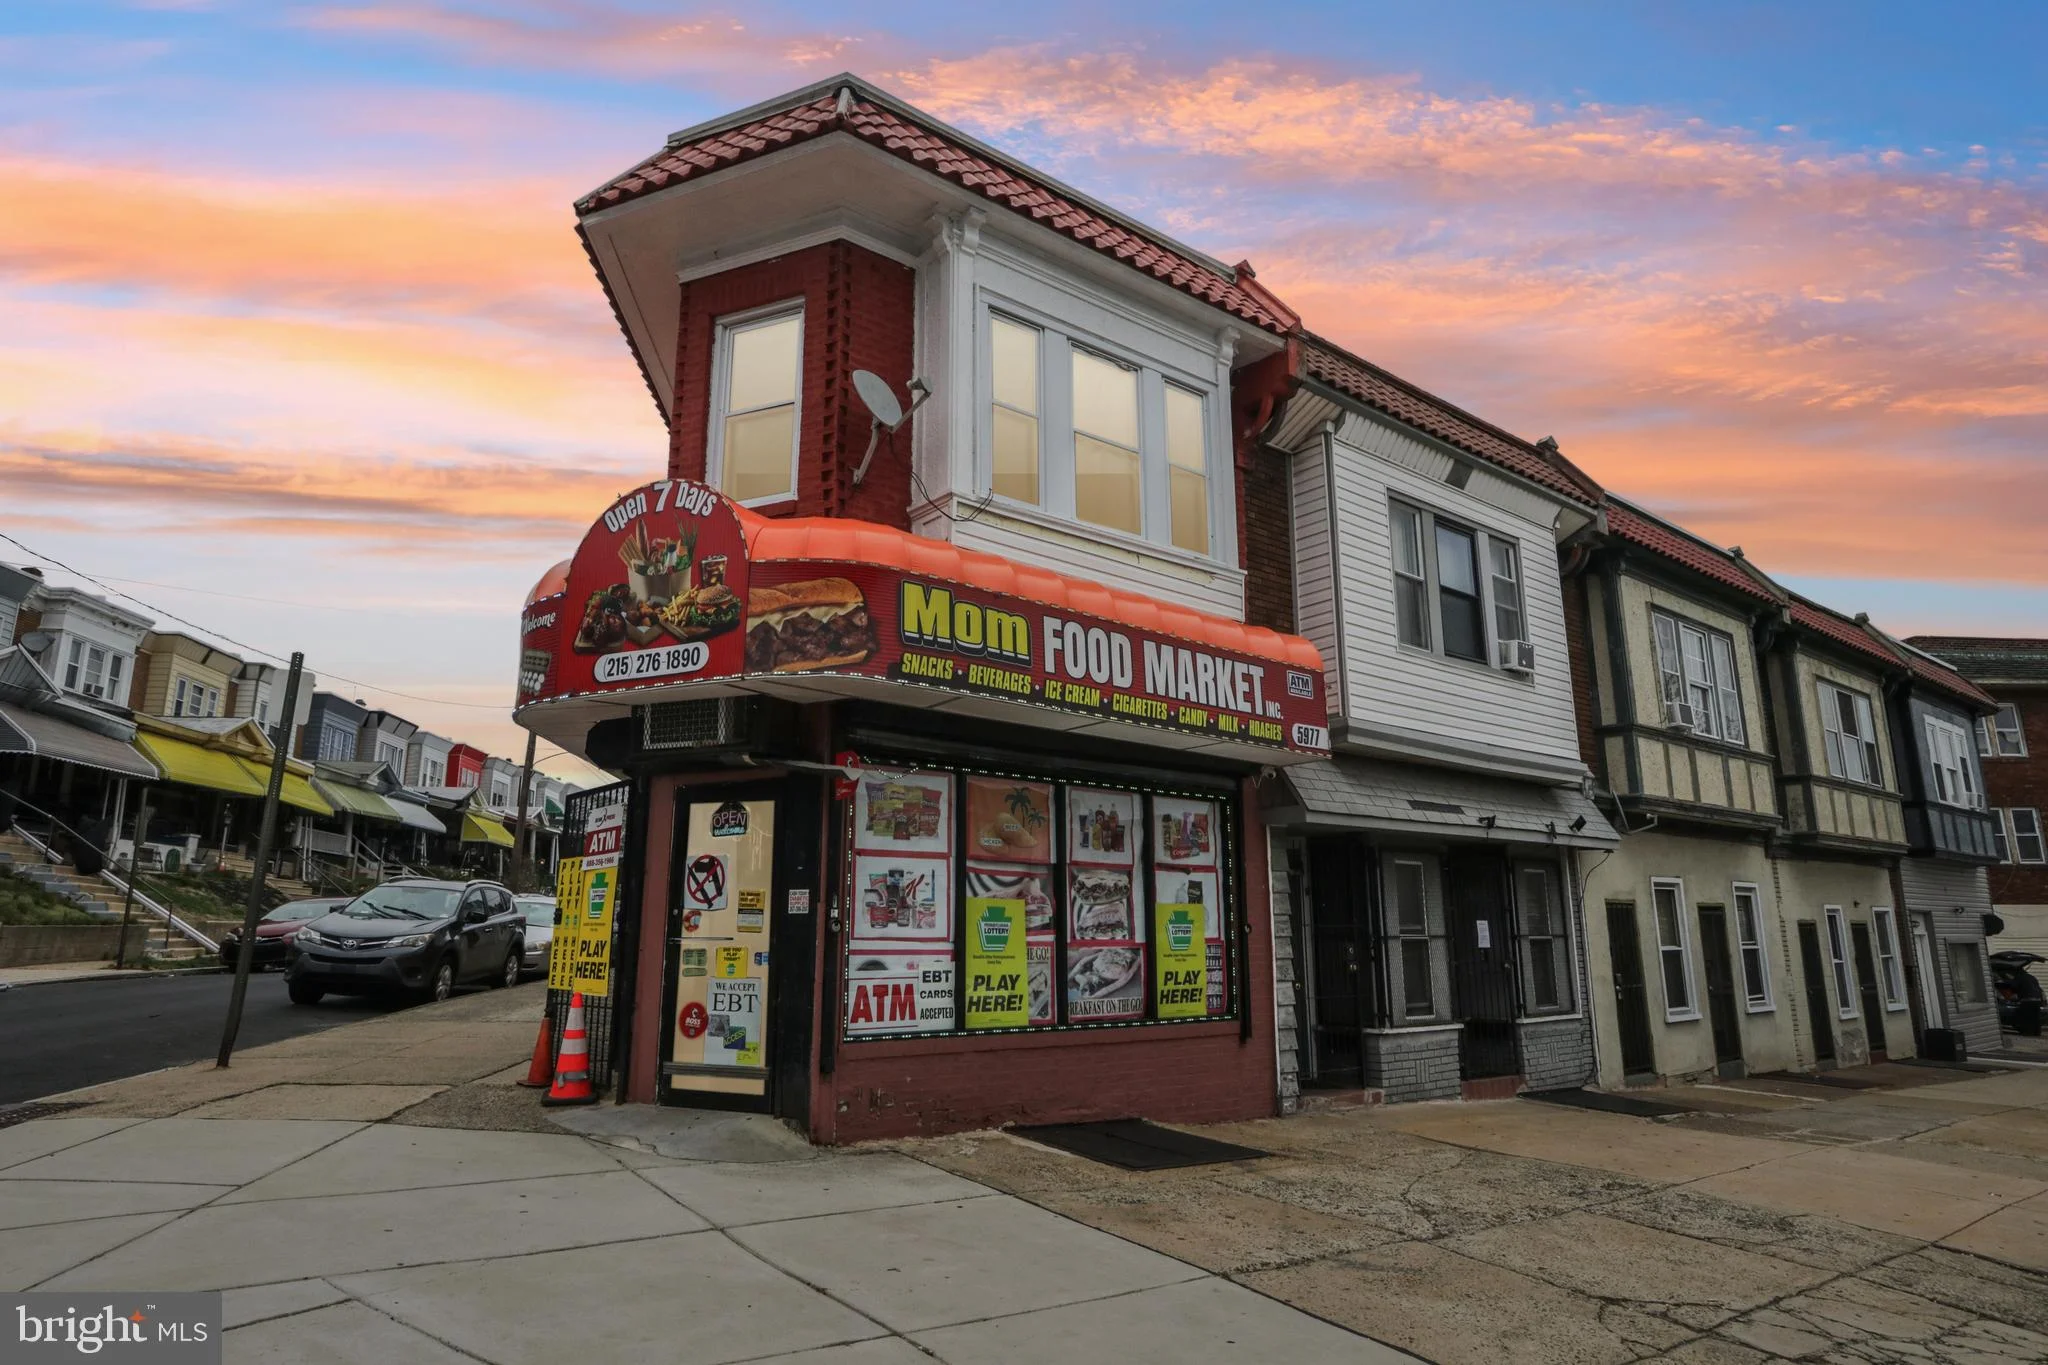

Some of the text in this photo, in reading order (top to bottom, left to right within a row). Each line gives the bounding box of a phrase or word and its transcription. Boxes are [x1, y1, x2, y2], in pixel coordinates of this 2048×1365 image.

[604, 481, 718, 533] Open 7 Days
[522, 612, 556, 637] Welcome
[903, 581, 1284, 720] Mom FOOD MARKET INC.
[603, 647, 700, 680] (215) 276-1890
[1290, 674, 1310, 690] ATM
[901, 653, 1282, 741] SNACKS BEVERAGES ICE CREAM CIGARETTES CANDY MILK HOAGIES
[1297, 725, 1320, 747] 5977
[713, 808, 747, 828] OPEN
[589, 829, 616, 853] ATM
[984, 927, 1009, 935] LOTTERY
[579, 940, 608, 958] PLAY
[550, 936, 560, 986] HERE
[559, 936, 569, 986] HERE
[568, 936, 577, 987] HERE
[575, 961, 608, 980] HERE!
[922, 970, 952, 983] EBT
[973, 974, 1021, 992] PLAY
[1164, 970, 1201, 986] PLAY
[715, 982, 757, 992] WE ACCEPT
[920, 990, 953, 999] CARDS
[1160, 988, 1203, 1005] HERE!
[712, 993, 758, 1013] EBT
[850, 984, 917, 1023] ATM
[967, 994, 1023, 1013] HERE!
[1106, 999, 1117, 1013] ON
[920, 1007, 954, 1020] ACCEPTED
